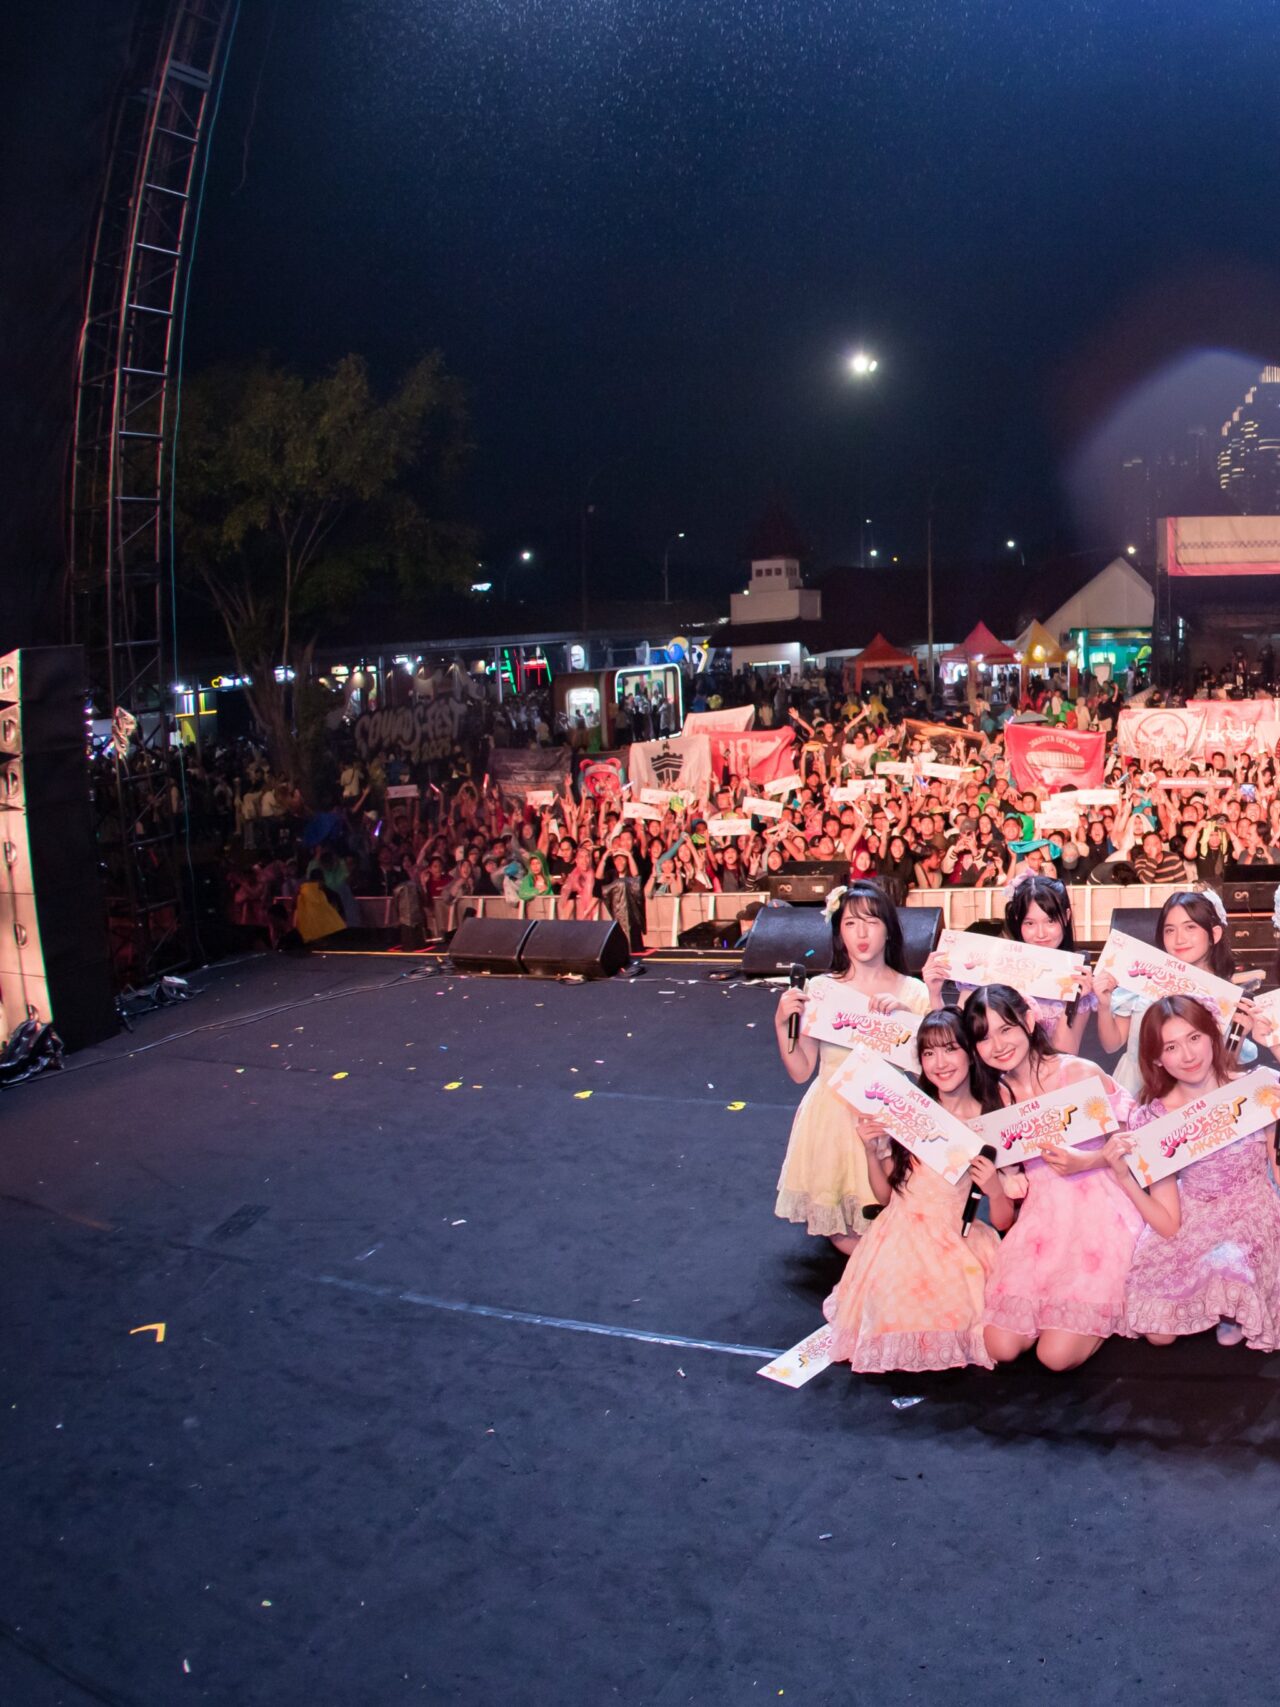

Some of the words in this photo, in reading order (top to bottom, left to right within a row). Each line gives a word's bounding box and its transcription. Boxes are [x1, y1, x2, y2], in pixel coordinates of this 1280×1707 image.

[907, 1089, 931, 1109] JKT48
[1020, 1101, 1040, 1117] JKT48
[1183, 1100, 1207, 1120] JKT48
[1204, 1117, 1232, 1136] 2025
[1187, 1127, 1238, 1158] JAKARTA
